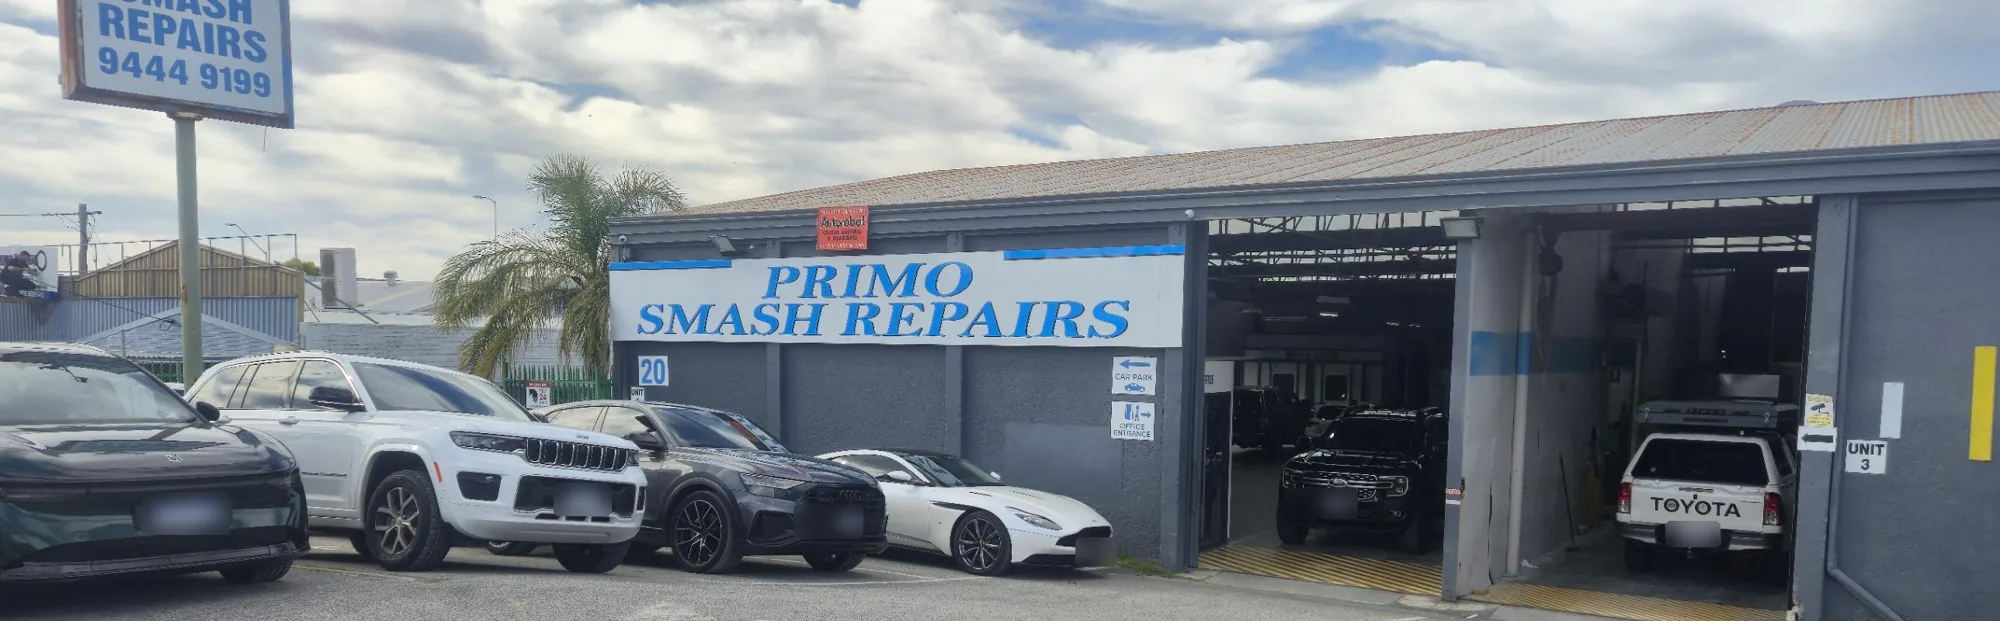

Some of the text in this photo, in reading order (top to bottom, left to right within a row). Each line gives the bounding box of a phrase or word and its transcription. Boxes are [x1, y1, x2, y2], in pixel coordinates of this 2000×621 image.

[118, 0, 253, 25] ASH
[99, 2, 268, 63] REPAIRS
[98, 47, 271, 98] 9444 9199
[761, 262, 974, 299] PRIMO
[637, 300, 1130, 339] SMASH REPAIRS
[640, 358, 666, 385] 20
[1115, 373, 1131, 381] CAR
[1113, 430, 1151, 438] ENTRANCE
[1848, 443, 1885, 456] UNIT
[1860, 458, 1870, 471] 3
[1650, 496, 1741, 518] TOYOTA
